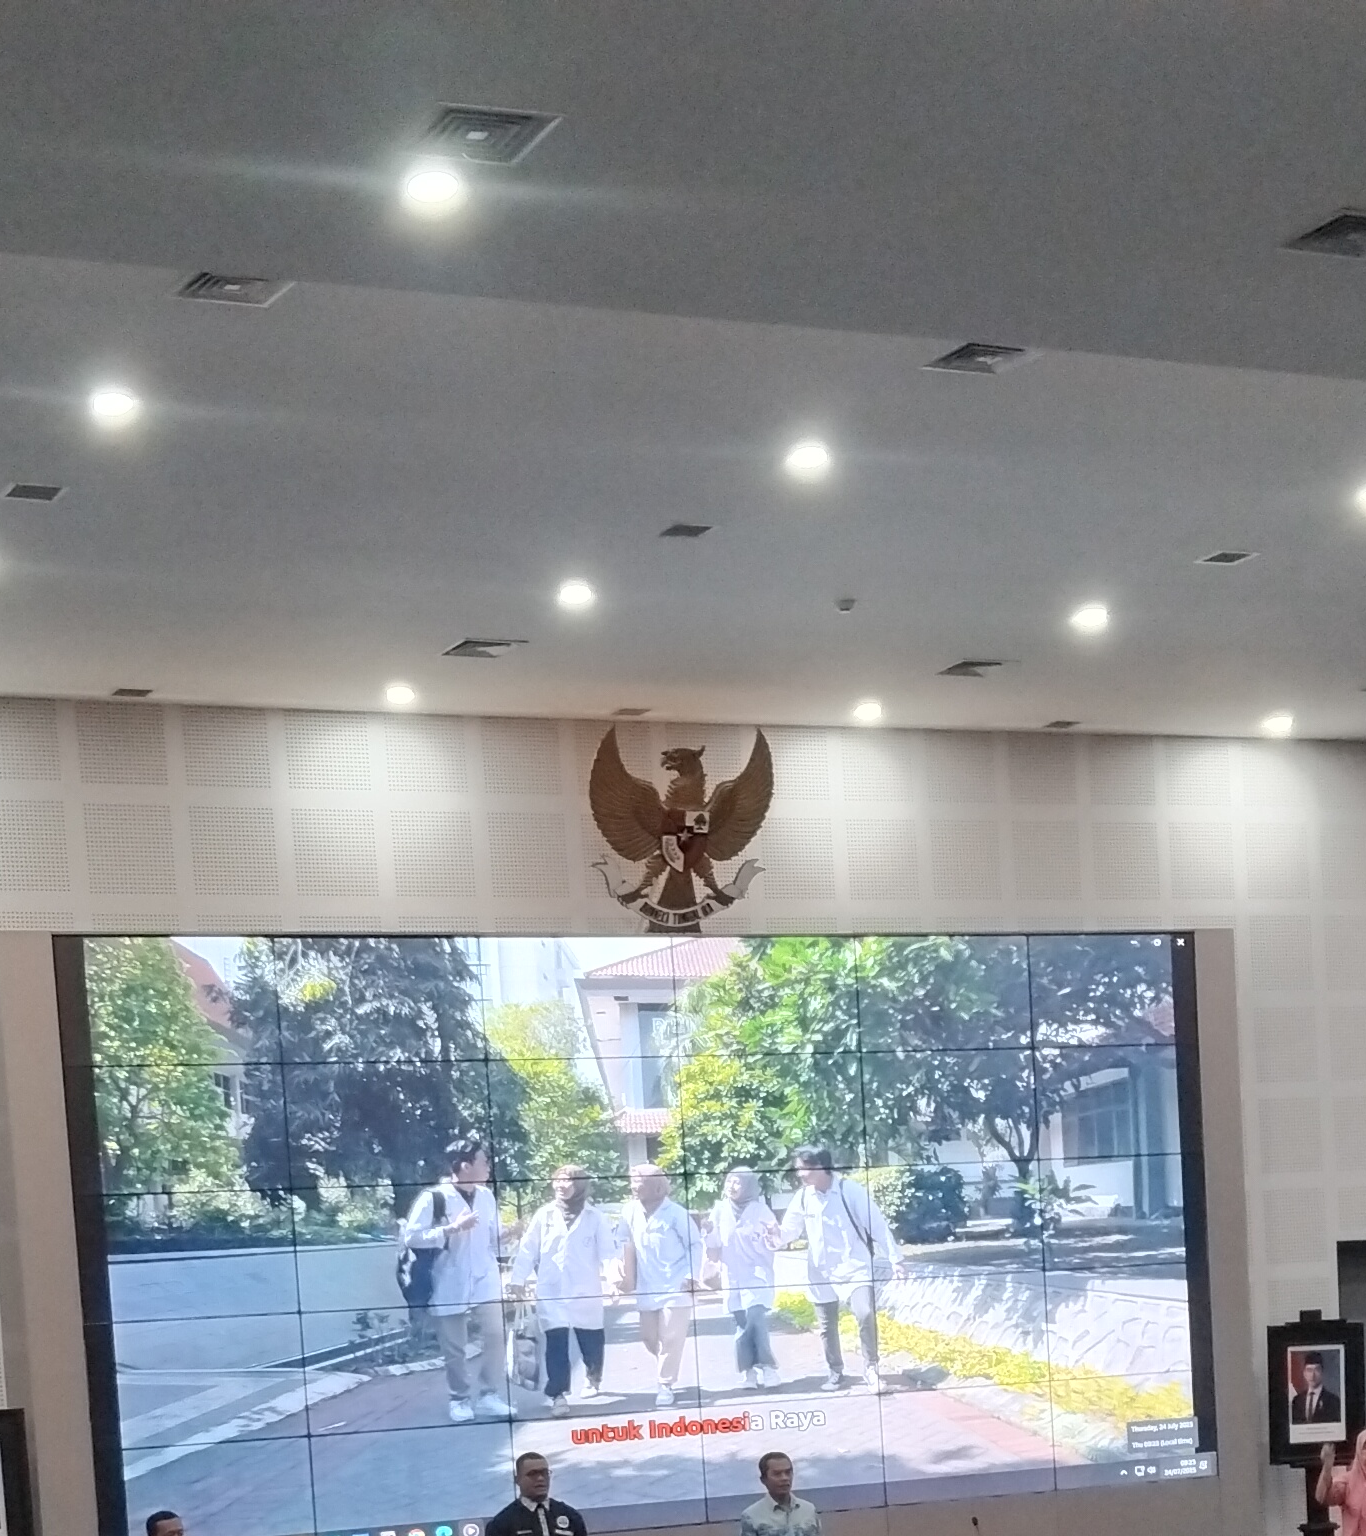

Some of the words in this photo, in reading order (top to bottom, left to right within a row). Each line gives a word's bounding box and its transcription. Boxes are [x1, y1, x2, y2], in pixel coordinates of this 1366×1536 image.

[571, 1419, 644, 1445] untuk
[648, 1410, 764, 1439] Indonesia
[769, 1409, 827, 1432] Raya
